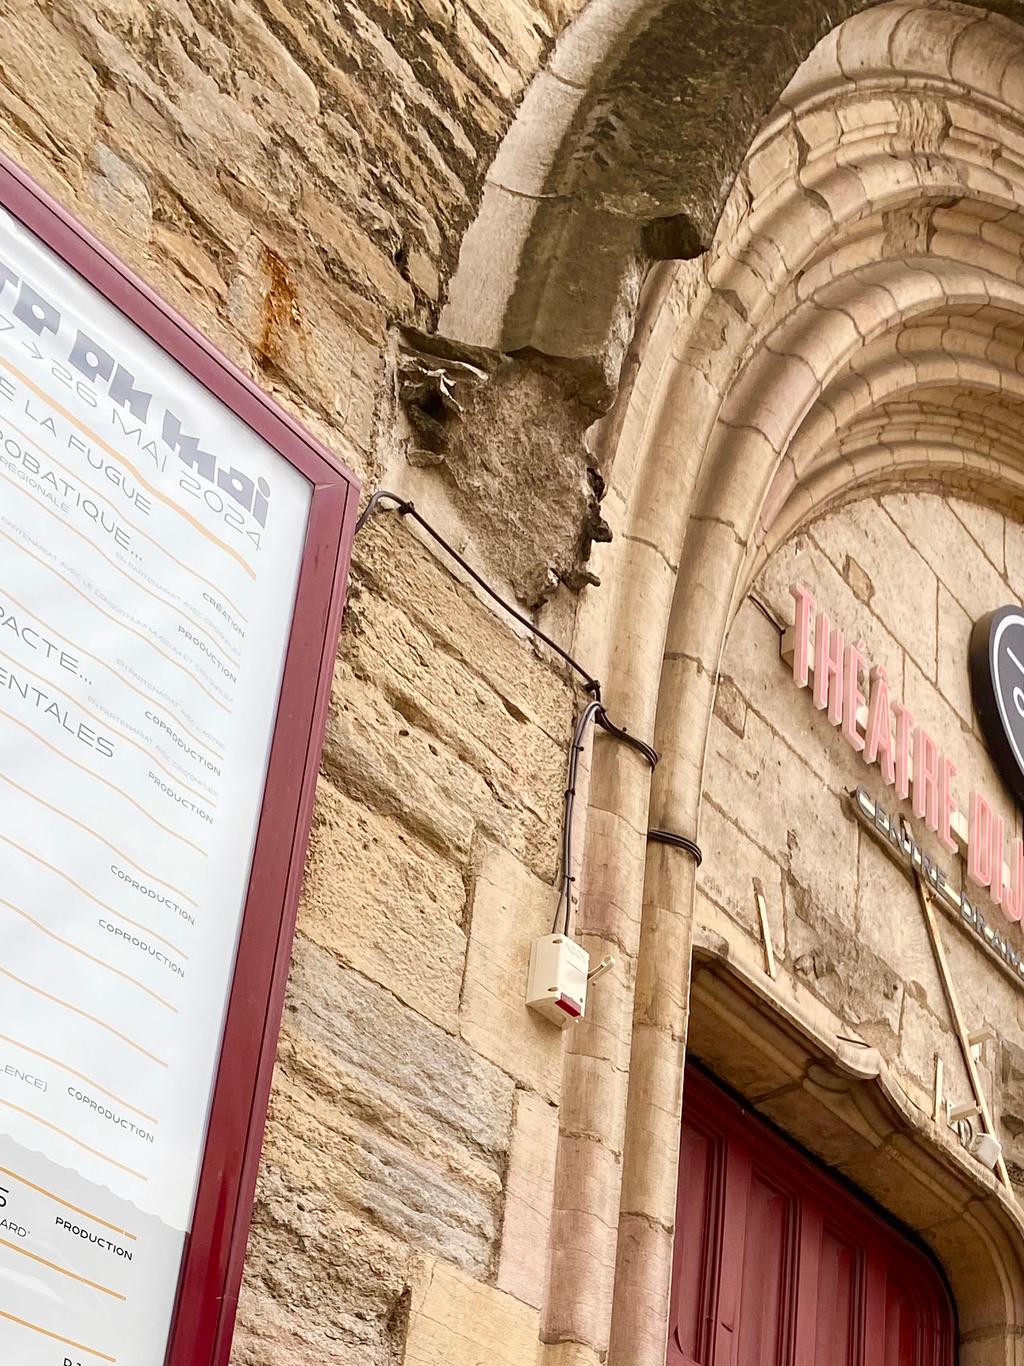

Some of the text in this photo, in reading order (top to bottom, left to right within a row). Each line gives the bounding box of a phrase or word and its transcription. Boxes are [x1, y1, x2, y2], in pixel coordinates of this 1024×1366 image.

[25, 399, 57, 437] LA
[68, 434, 152, 515] FUGUE
[51, 358, 98, 407] 26
[112, 408, 167, 473] MAI
[179, 470, 261, 552] 2024
[0, 430, 143, 561] OBATIQUE...
[202, 592, 245, 638] CRÉATION
[178, 625, 237, 684] PRODUCTION
[144, 710, 221, 777] COPRODUCTION
[788, 581, 959, 855] THÉÂTRE
[147, 770, 213, 825] PRODUCTION
[856, 784, 949, 901] CENTRE
[110, 864, 195, 926] COPRODUCTION
[98, 918, 185, 978] COPRODUCTION
[0, 1062, 48, 1092] ENCE)
[67, 1086, 154, 1143] COPRODUCTION
[55, 1216, 133, 1261] PRODUCTION
